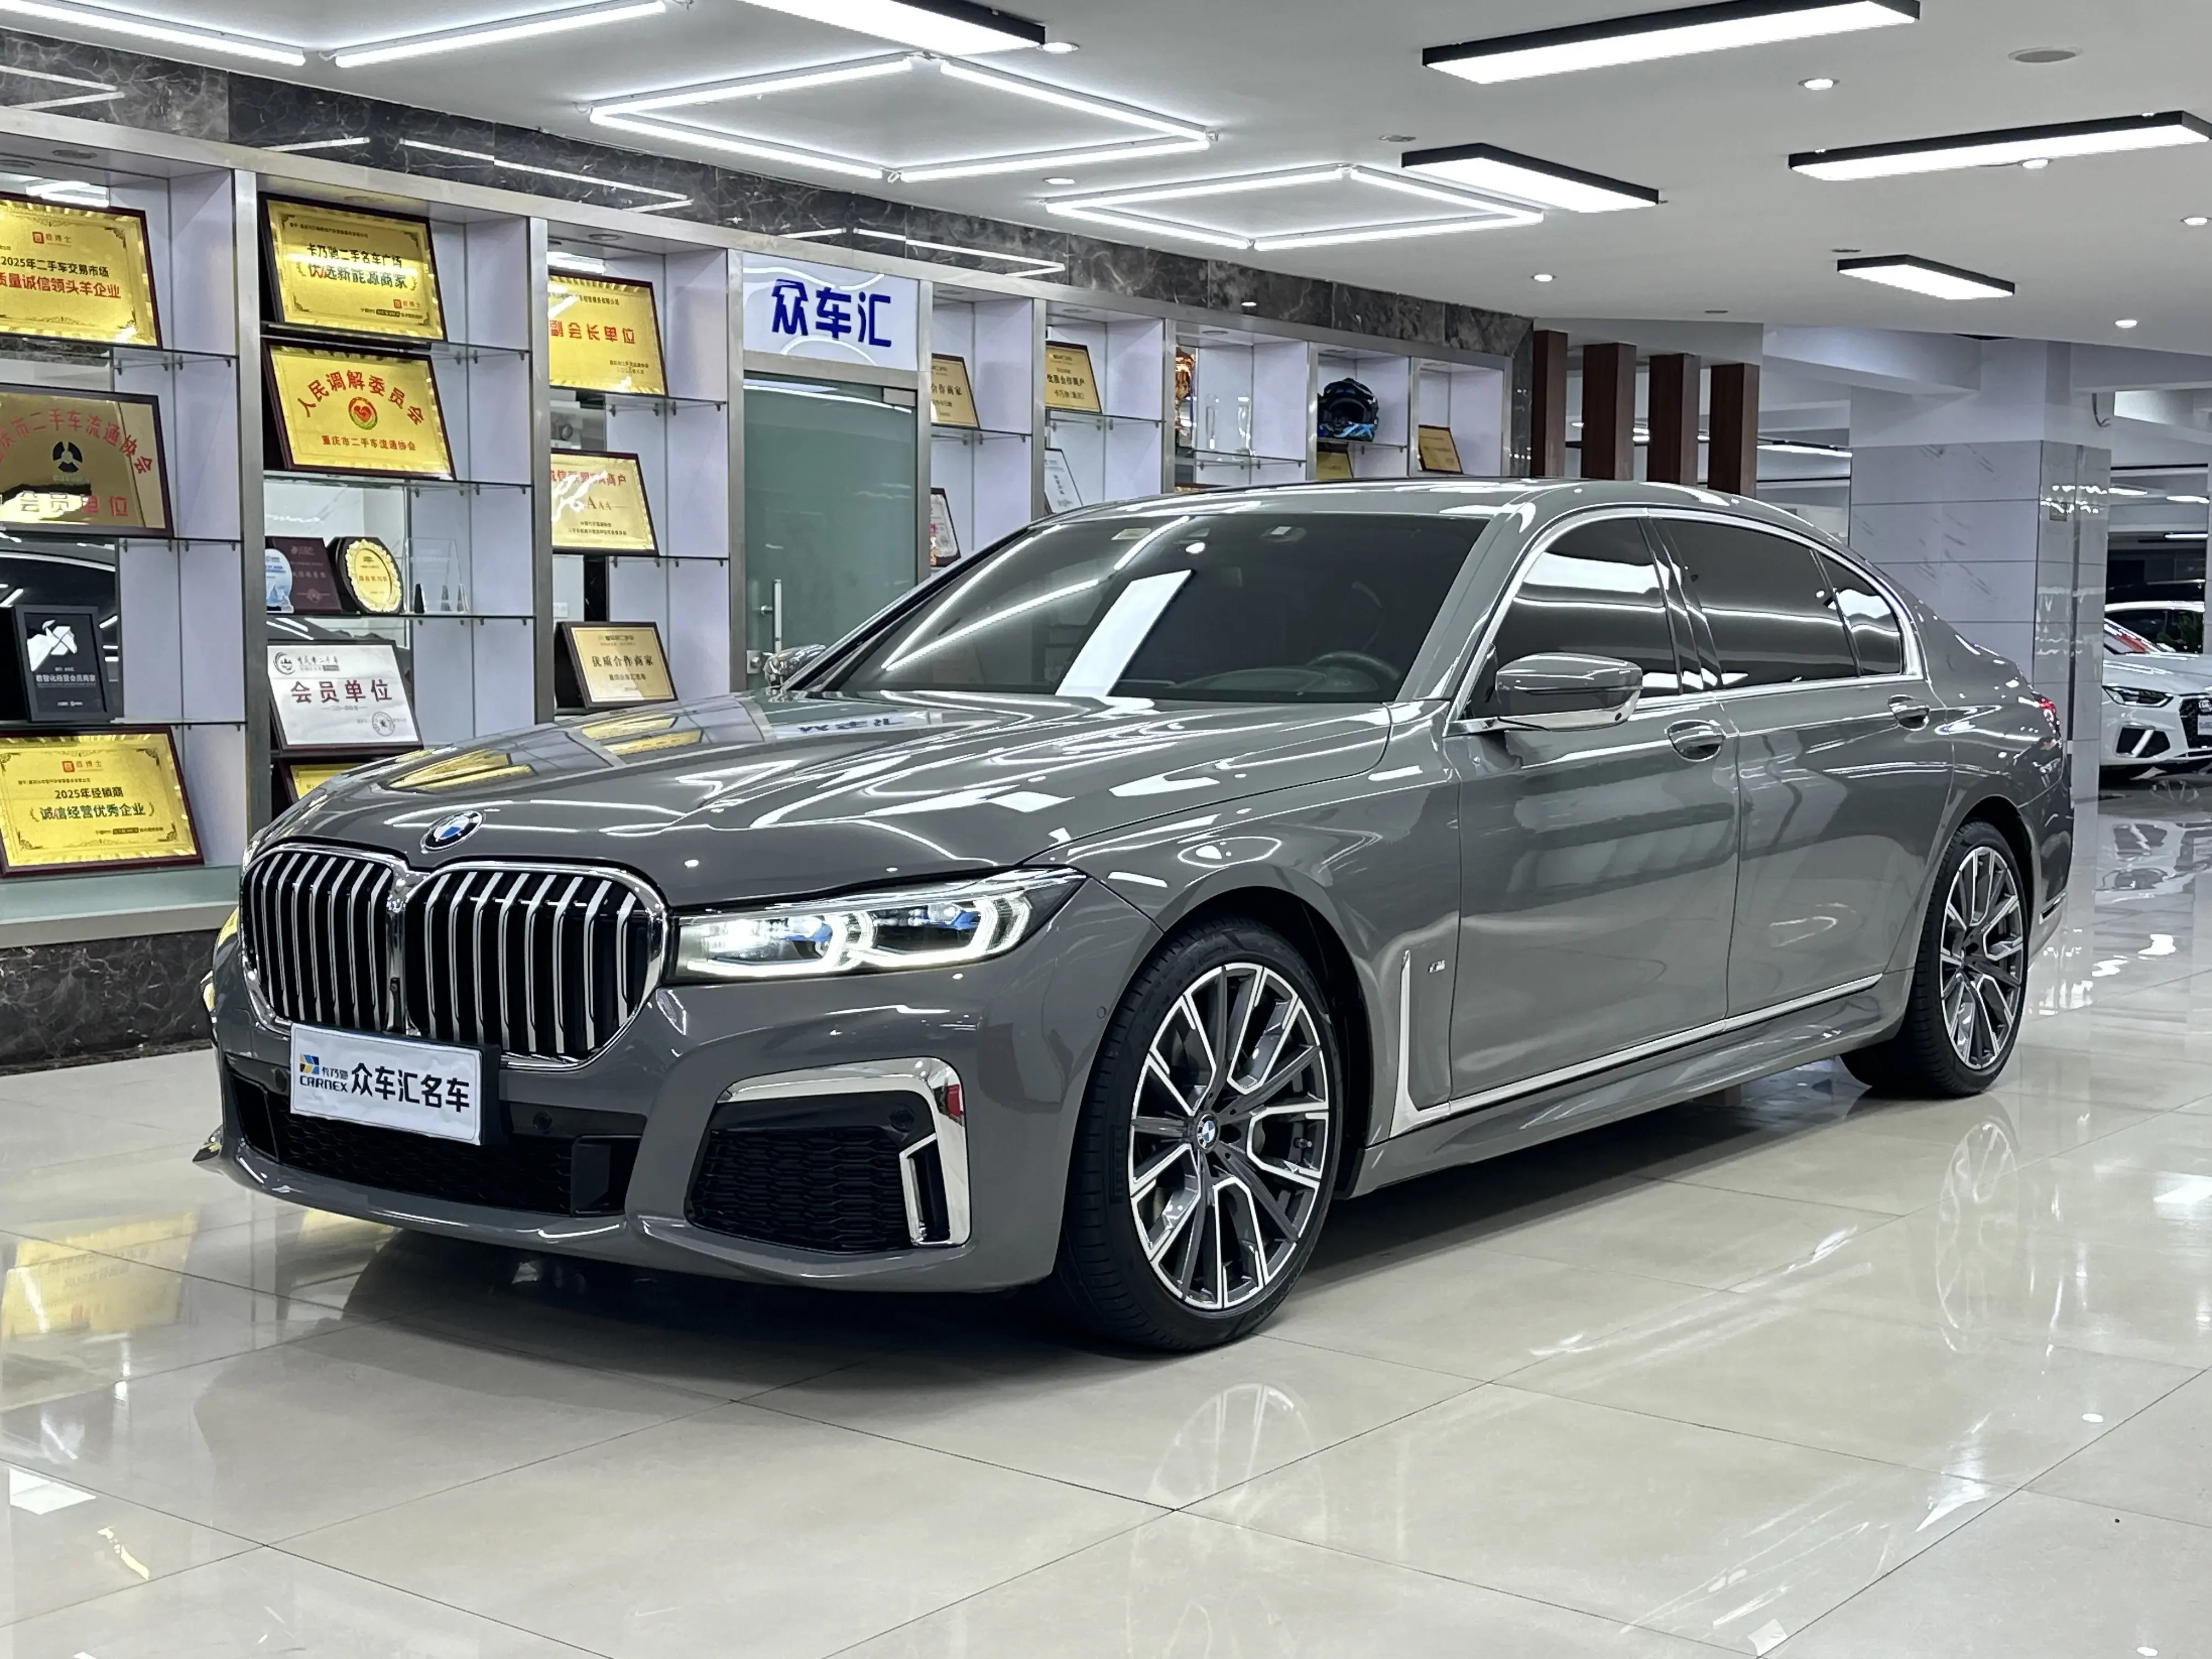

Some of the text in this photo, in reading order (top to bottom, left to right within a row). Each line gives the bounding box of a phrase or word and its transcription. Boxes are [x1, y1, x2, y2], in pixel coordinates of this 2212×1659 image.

[1, 256, 109, 278] 2025年二手车交易市场
[771, 278, 893, 347] 众车汇
[549, 320, 636, 345] 副会长单位
[297, 370, 425, 426] 人民调解委员会
[0, 408, 153, 475] 庆市二手车流通协会
[321, 435, 416, 452] 重庆市二手车流通协会
[290, 679, 393, 704] 会员单位
[54, 786, 125, 800] 2025年经销商
[40, 802, 146, 821] 诚信经营优秀企业
[300, 1075, 349, 1093] CARNEX
[351, 1062, 470, 1113] 众车汇名车
